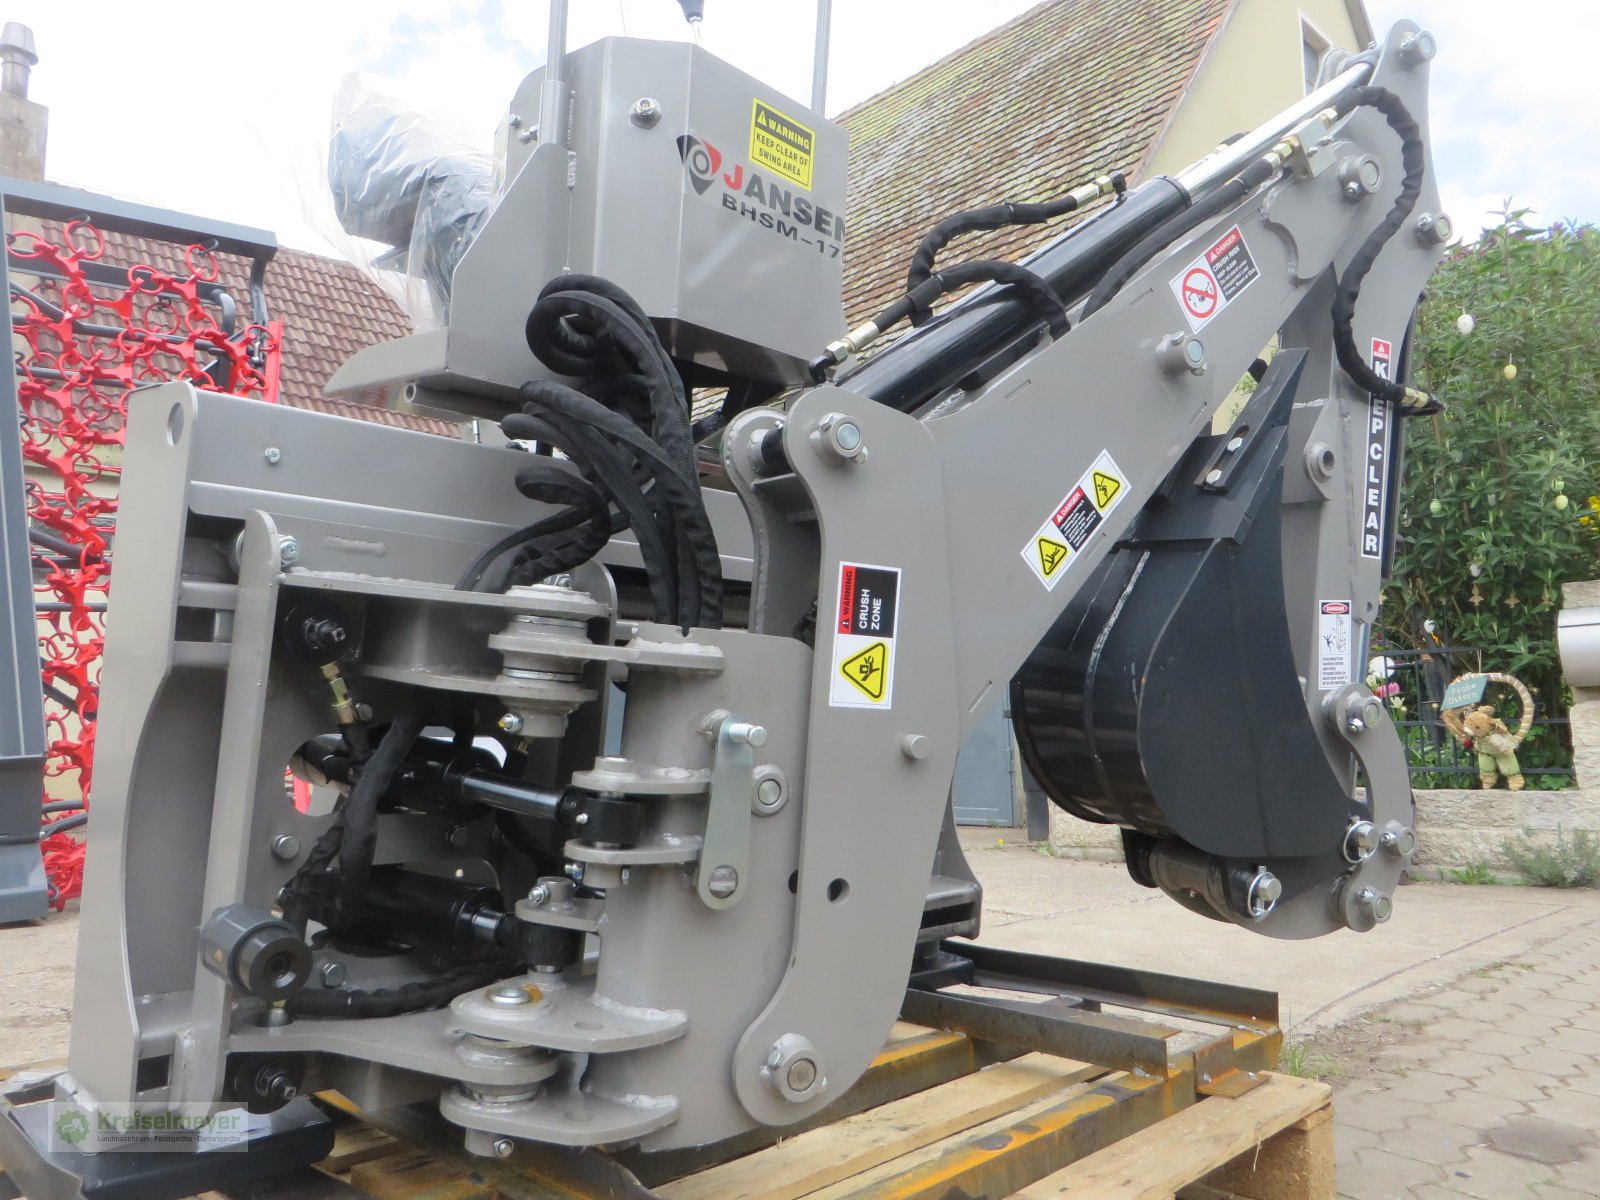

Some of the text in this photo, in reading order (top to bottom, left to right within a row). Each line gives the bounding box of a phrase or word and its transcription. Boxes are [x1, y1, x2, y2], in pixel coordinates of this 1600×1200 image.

[768, 118, 811, 149] WARNING
[756, 133, 809, 167] KEEP CLEAR OF
[759, 148, 801, 176] SWING AREA
[1216, 234, 1236, 254] DANGER
[1213, 254, 1230, 272] CRUSH
[1365, 360, 1388, 552] KEP CLEAR
[1061, 491, 1081, 516] DANGER
[843, 570, 853, 615] WARNING
[859, 588, 870, 629] CRUSH
[871, 598, 882, 630] ZONE
